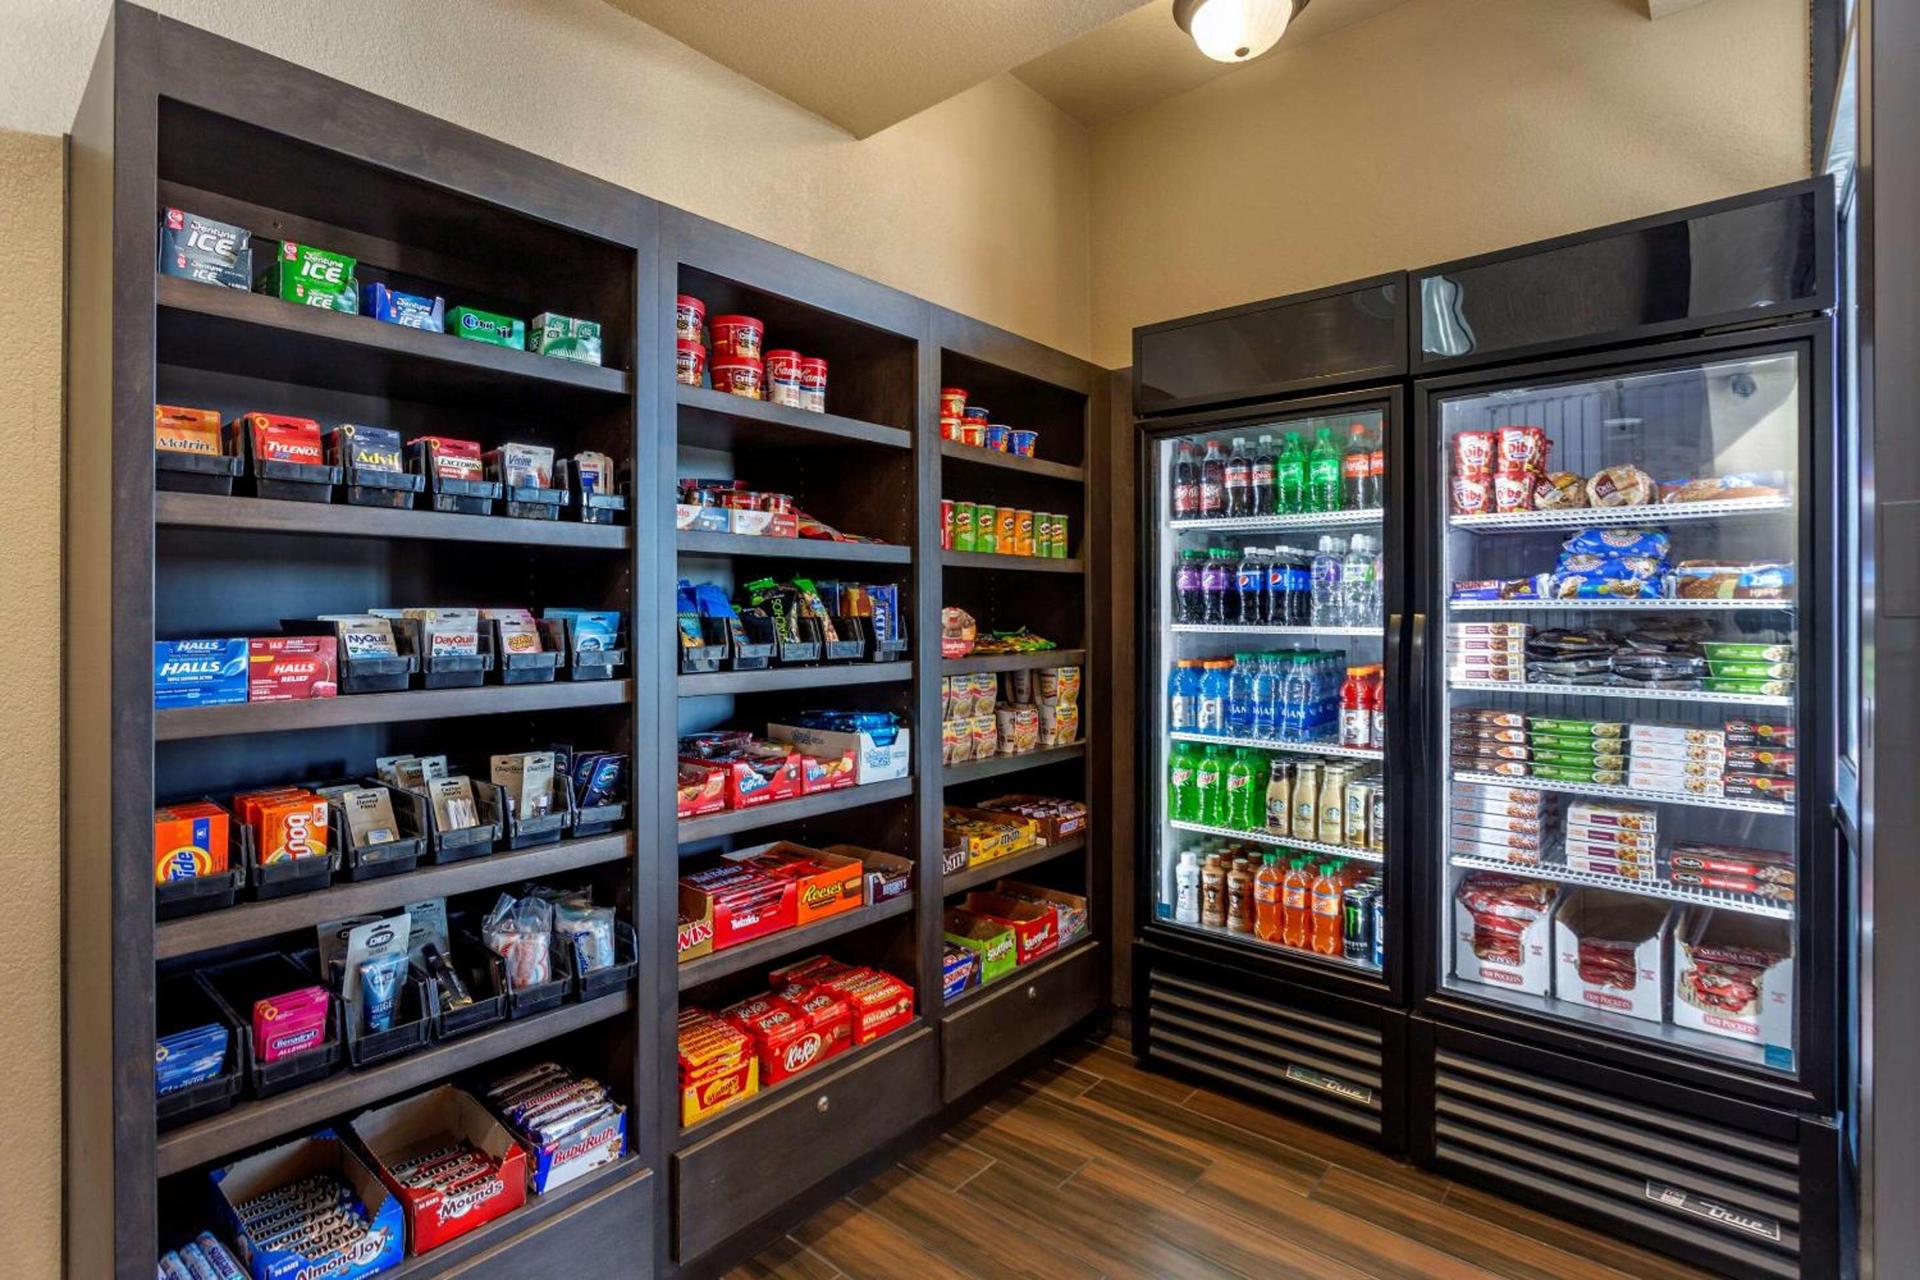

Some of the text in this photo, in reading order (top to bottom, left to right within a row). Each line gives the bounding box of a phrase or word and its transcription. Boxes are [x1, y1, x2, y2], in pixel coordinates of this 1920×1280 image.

[187, 230, 235, 256] ICE
[193, 269, 218, 281] ICE
[301, 262, 343, 283] ICE
[306, 295, 333, 310] ICE
[267, 440, 320, 457] TYLENOL
[356, 450, 399, 466] Advil
[1497, 487, 1522, 499] Dbs
[177, 642, 219, 651] HALLS
[348, 634, 387, 645] NyQuil
[435, 635, 474, 645] DayQuil
[160, 661, 220, 676] HALLS
[274, 663, 315, 673] HALLS
[677, 921, 714, 953] WIX
[440, 1181, 502, 1218] Mounds
[1700, 1201, 1772, 1235] True
[296, 1236, 384, 1280] Almond Joy
